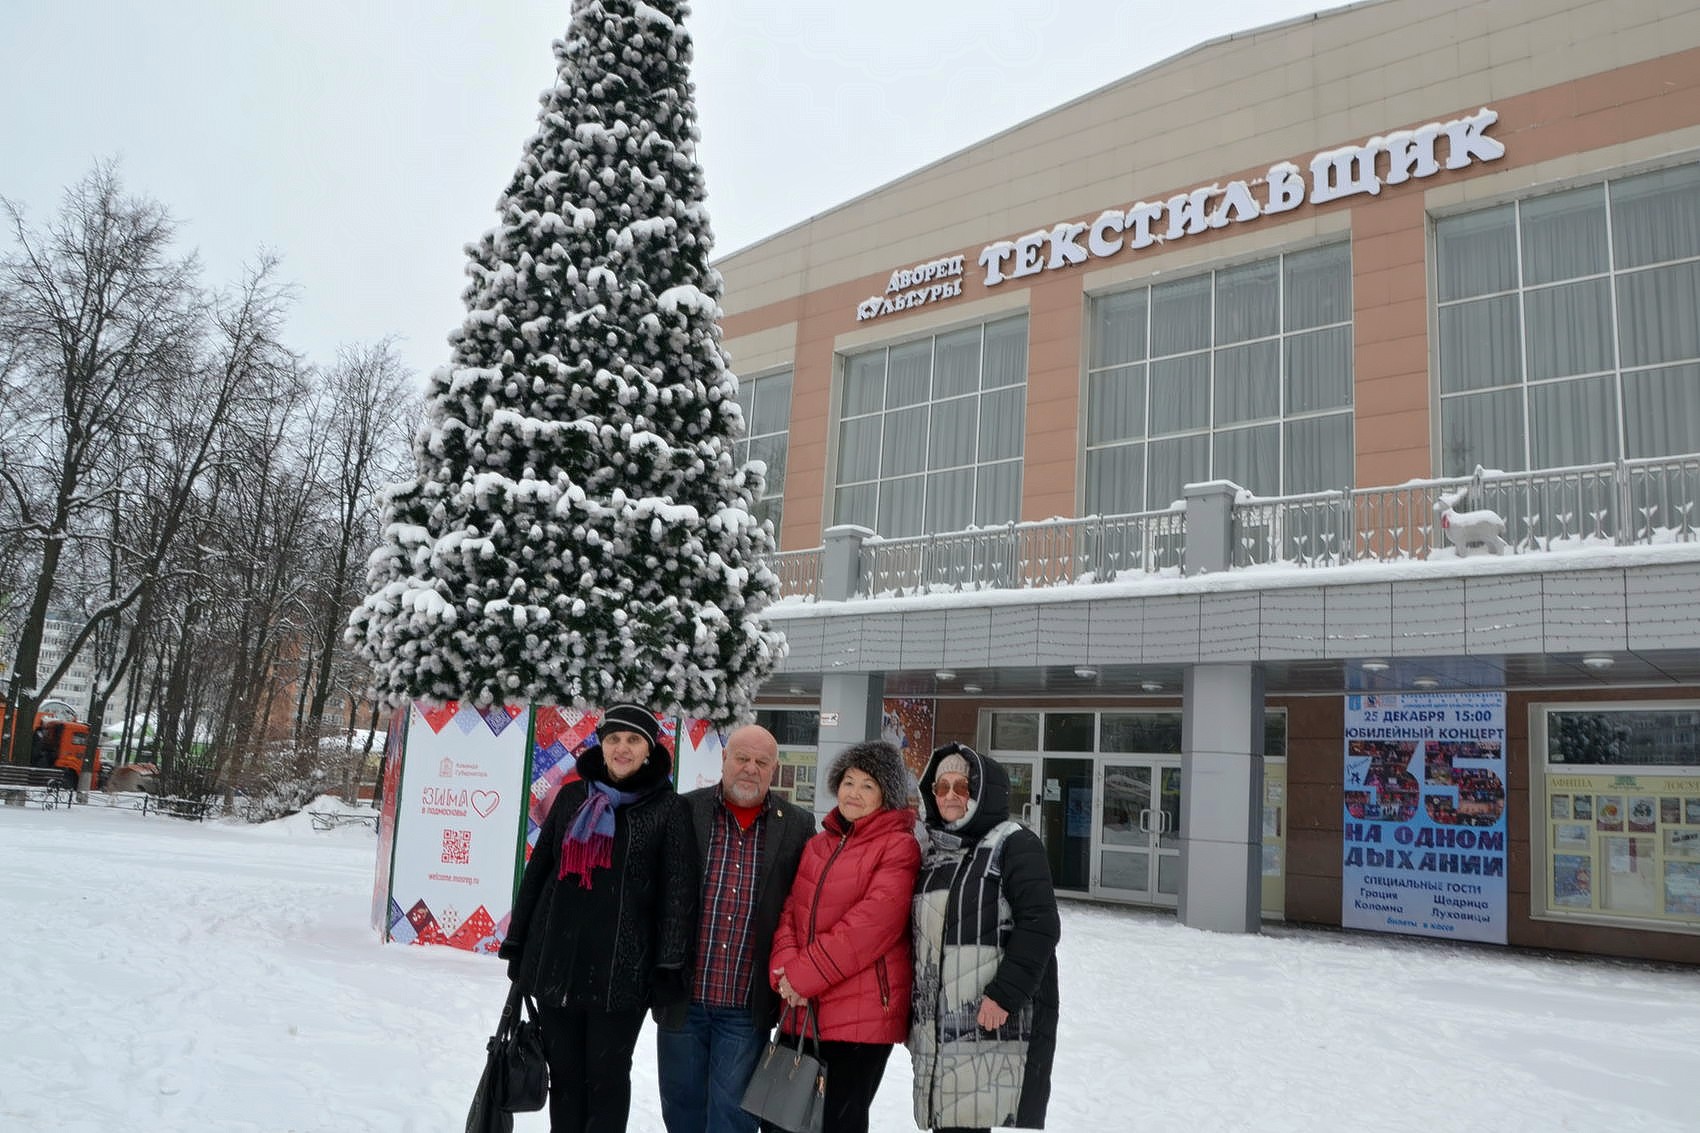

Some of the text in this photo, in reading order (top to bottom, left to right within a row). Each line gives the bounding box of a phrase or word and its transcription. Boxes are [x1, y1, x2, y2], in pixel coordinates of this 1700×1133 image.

[979, 107, 1505, 287] ТЕКСТИЛЬЩИК
[886, 254, 965, 295] ДВОРЕЦ
[856, 278, 963, 321] КУЛЬТУРЫ
[1364, 710, 1492, 722] 25 ДЕКАБРЯ 15:00
[1345, 726, 1504, 740] ЮБИЛЕЙНЫЙ КОНЦЕРТ
[1345, 740, 1505, 827] 35
[423, 786, 469, 807] ЗИМА
[1345, 823, 1504, 851] НА ОДНОМ
[1344, 846, 1504, 877] ДЫХАНИИ
[1360, 888, 1398, 900] Грация
[1447, 883, 1481, 894] ГОСТИ
[1354, 900, 1403, 913] Коломна
